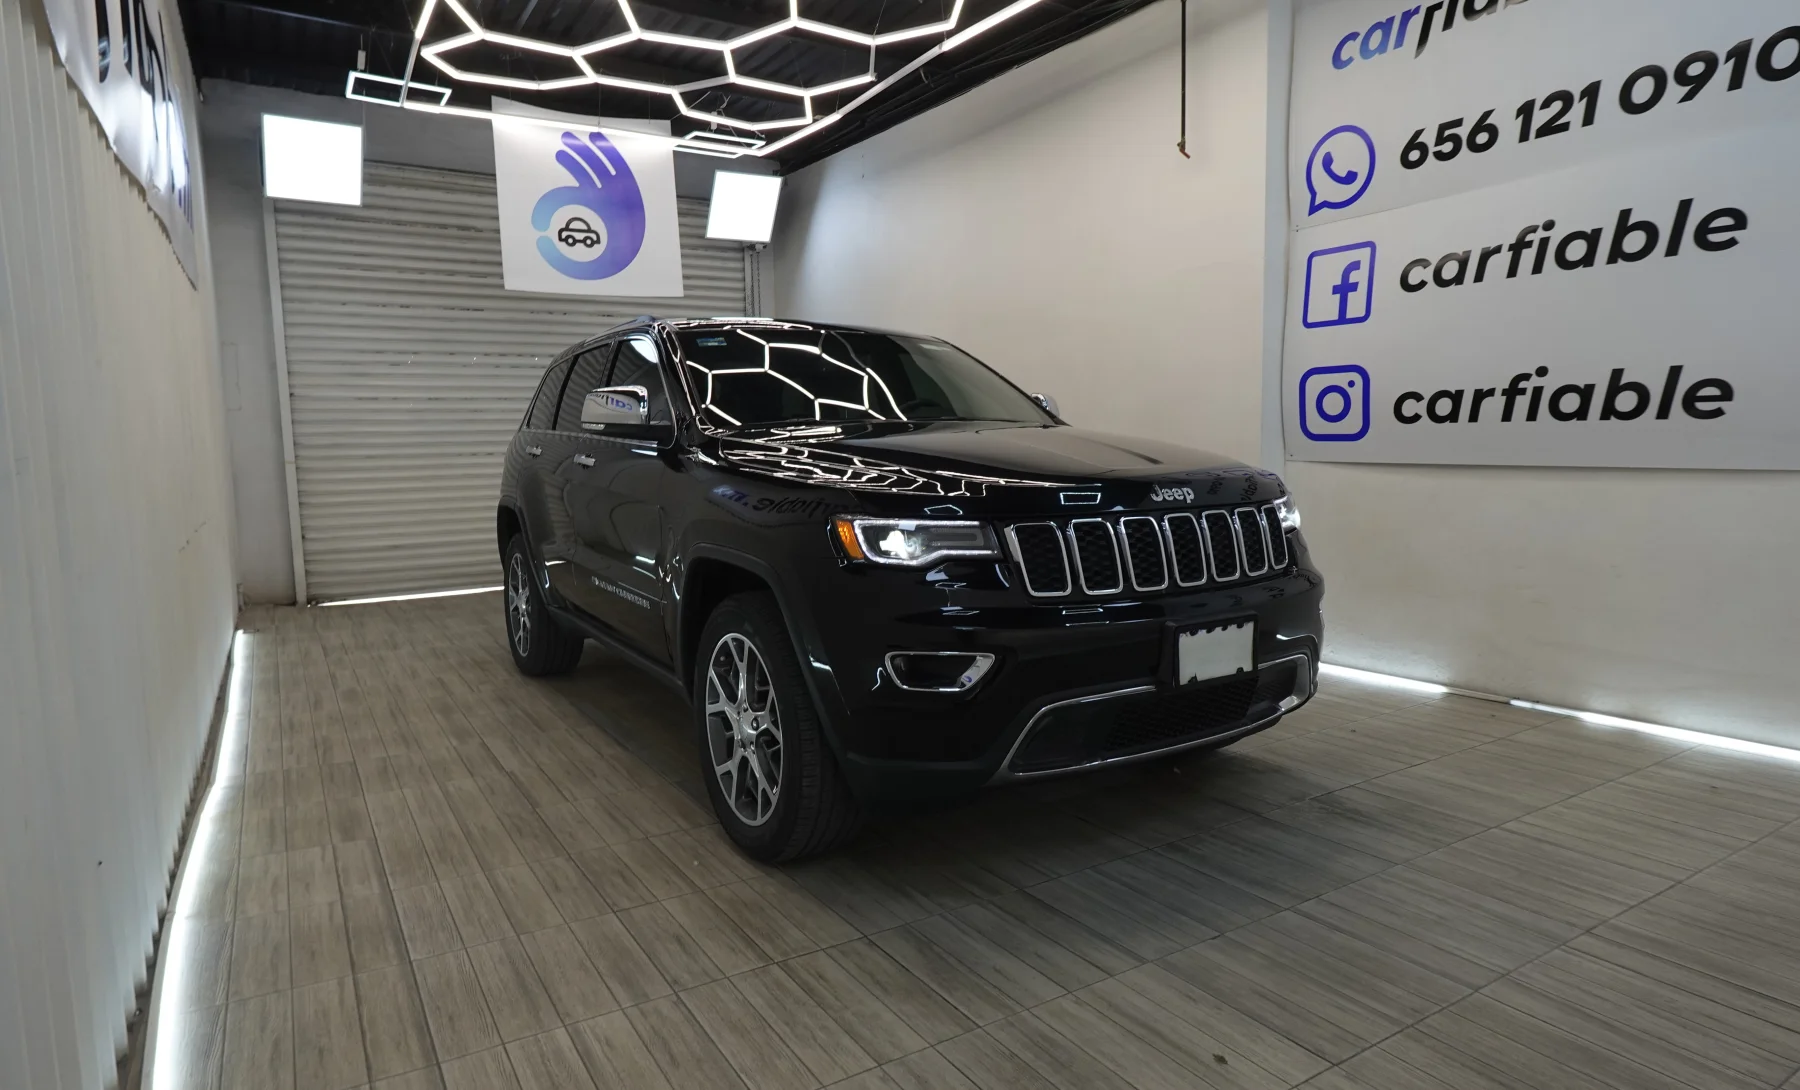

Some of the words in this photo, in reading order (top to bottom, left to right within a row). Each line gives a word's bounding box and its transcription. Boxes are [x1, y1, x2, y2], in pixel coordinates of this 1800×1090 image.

[1400, 109, 1499, 170] 656
[1515, 80, 1602, 144] 121
[1619, 25, 1800, 115] 0910
[1400, 198, 1748, 293] carfiable
[1393, 365, 1734, 425] carfiable
[1150, 485, 1195, 503] Jeep
